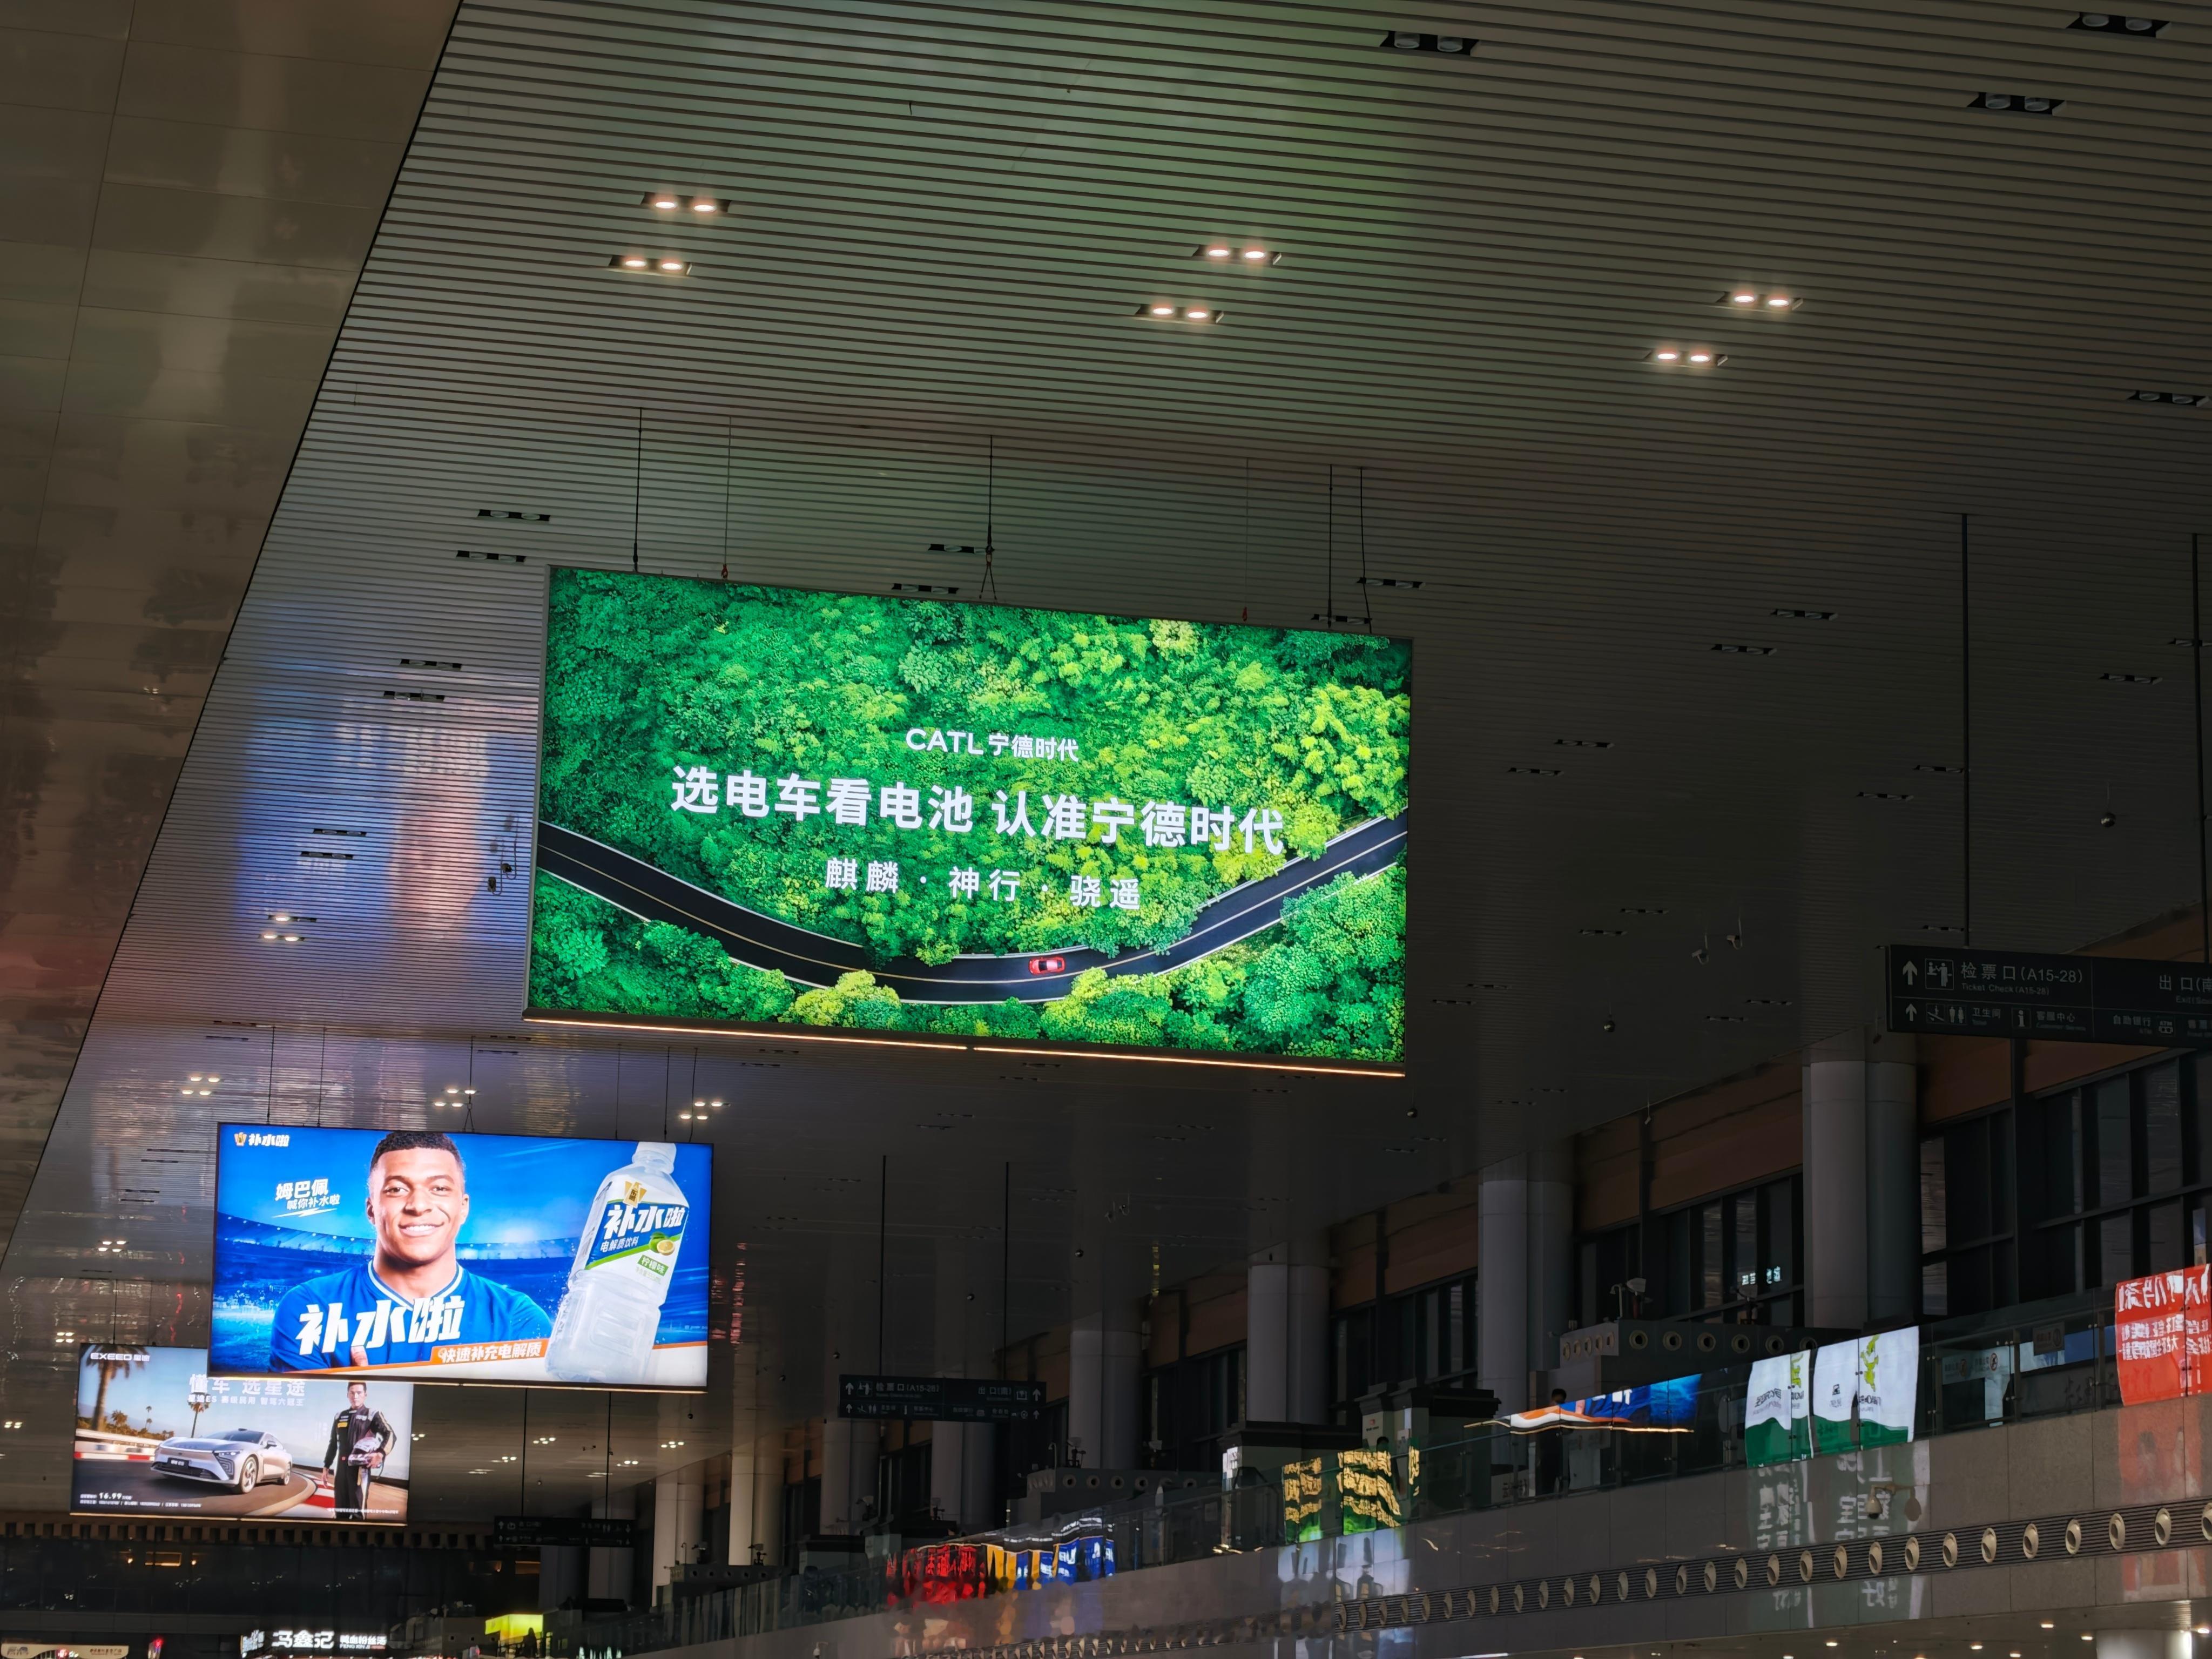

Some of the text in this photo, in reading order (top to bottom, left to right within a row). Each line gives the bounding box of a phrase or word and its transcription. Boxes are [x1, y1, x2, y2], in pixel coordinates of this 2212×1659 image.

[906, 729, 1080, 763] CATL 宁德时代
[671, 765, 1285, 855] 选电车看电池 认准宁德时代
[248, 1133, 290, 1147] 补水啦
[275, 1178, 329, 1202] 姆巴佩
[287, 1193, 341, 1210] 喊你补水啦
[604, 1204, 686, 1240] 补水啦
[600, 1236, 639, 1253] 电解质饮料
[295, 1295, 466, 1356] 补水啦
[90, 1352, 132, 1361] EXEED
[442, 1341, 542, 1364] 快速补充电解质
